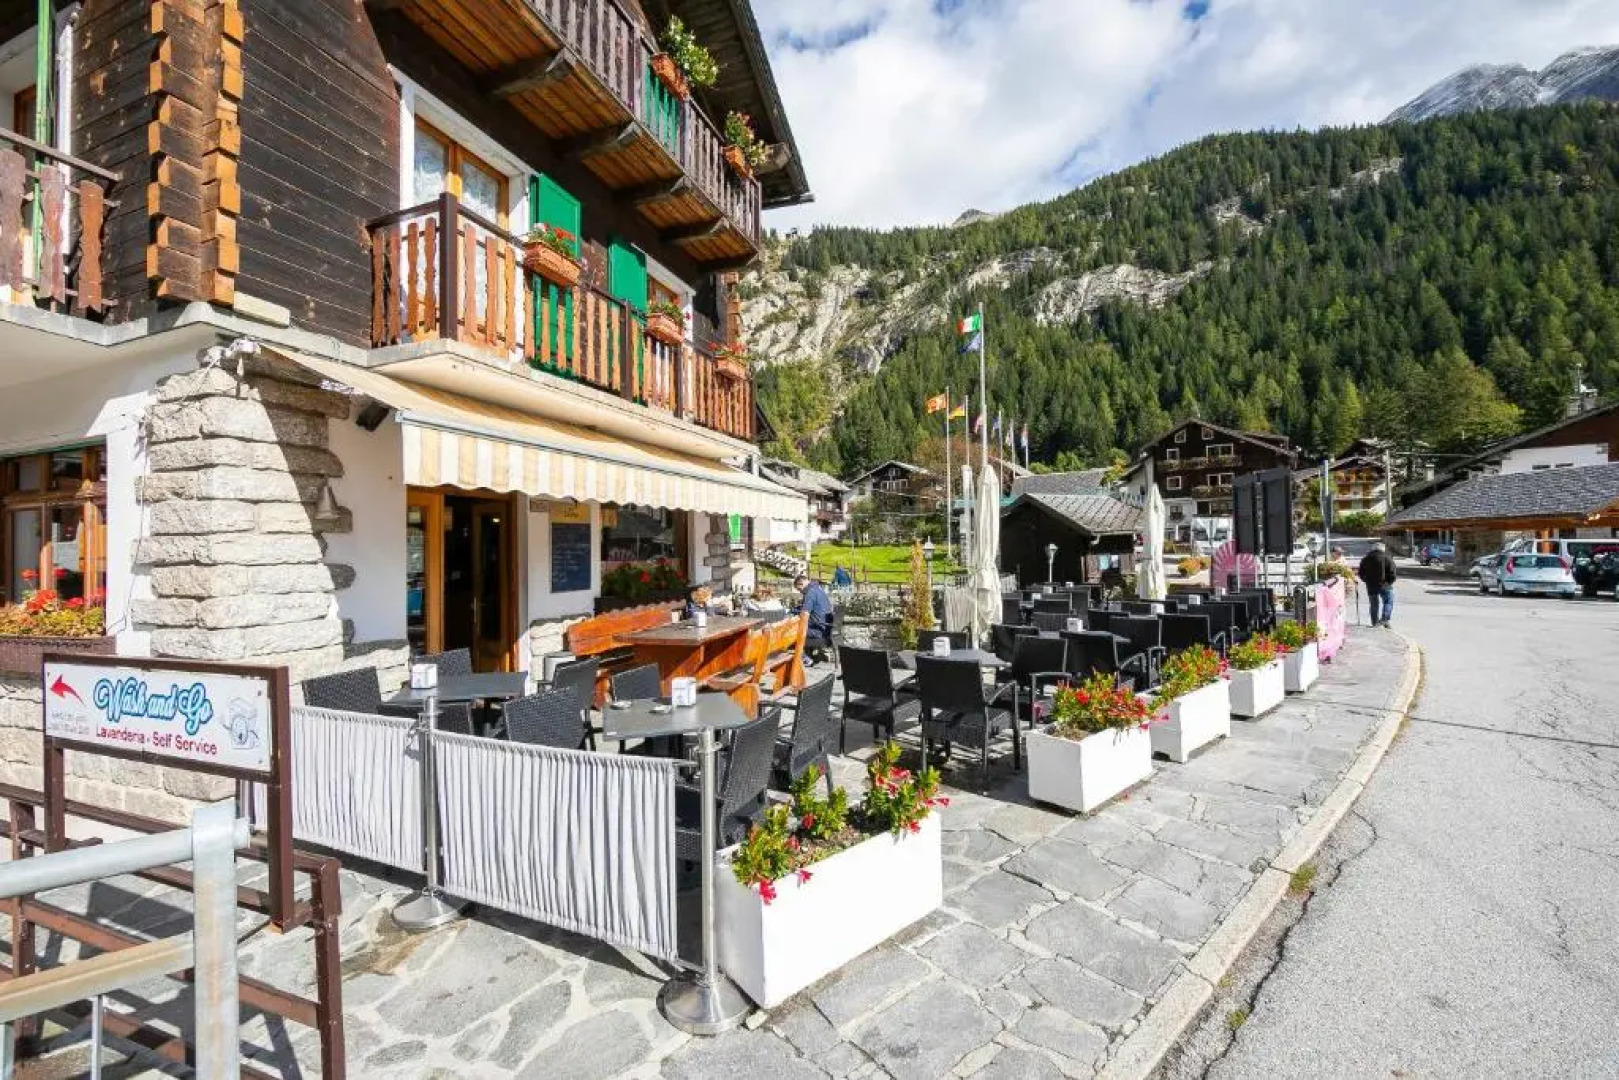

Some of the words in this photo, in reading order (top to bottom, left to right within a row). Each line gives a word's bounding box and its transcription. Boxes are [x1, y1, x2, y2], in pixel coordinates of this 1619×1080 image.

[94, 677, 147, 722] Wash
[148, 684, 178, 720] and
[178, 682, 213, 735] Go
[152, 732, 172, 748] Self
[175, 735, 217, 755] Service
